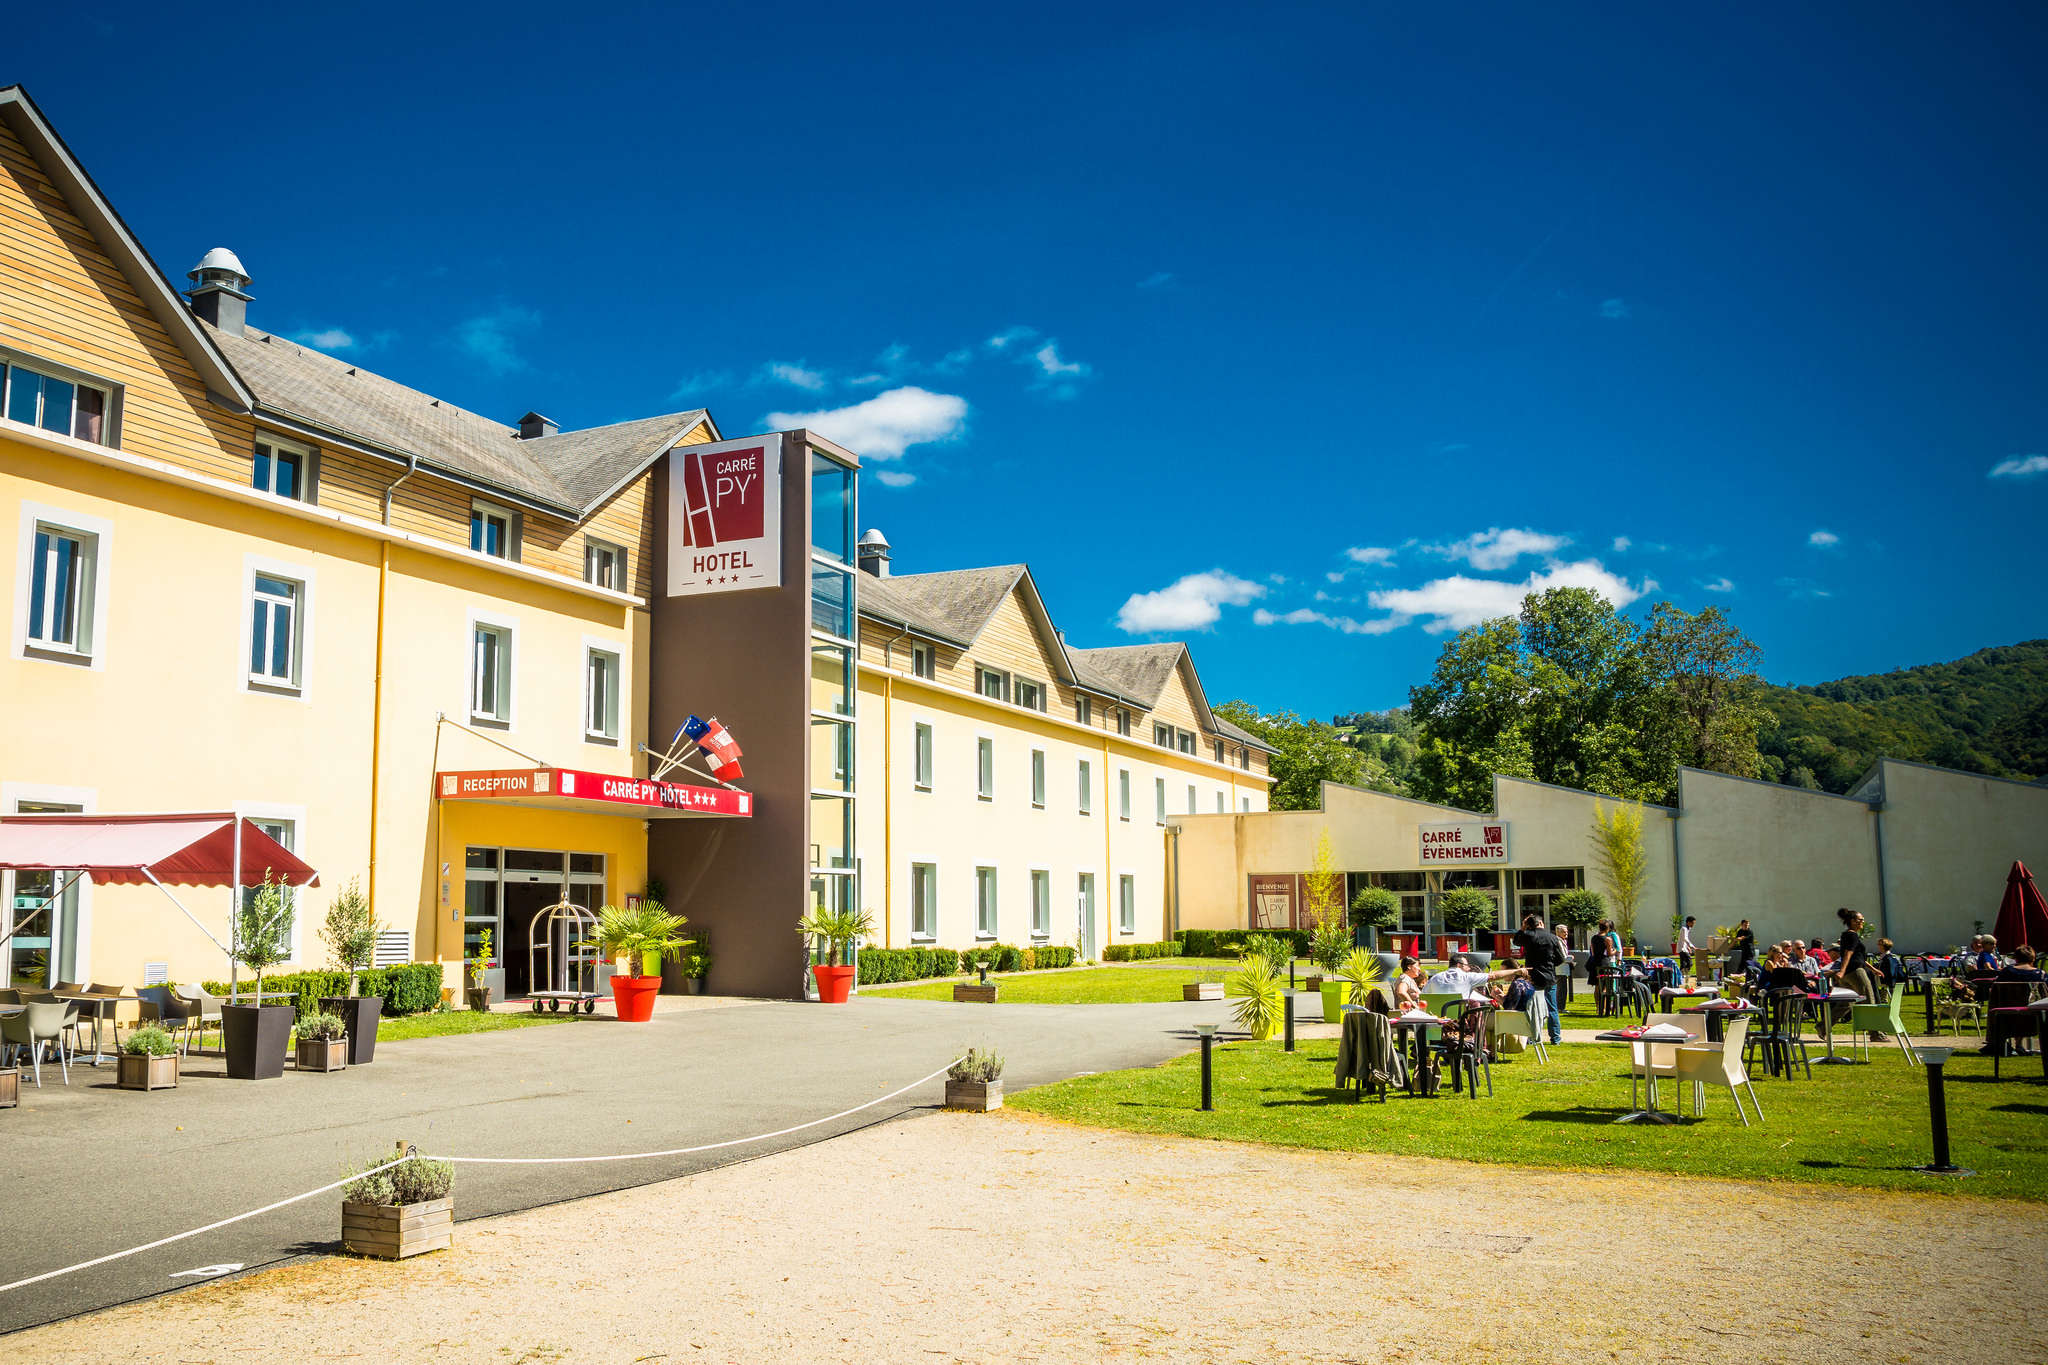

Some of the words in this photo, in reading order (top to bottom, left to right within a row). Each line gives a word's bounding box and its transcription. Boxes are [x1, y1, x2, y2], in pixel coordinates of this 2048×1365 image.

[716, 454, 756, 474] CARRÉ
[693, 551, 753, 573] HOTEL
[463, 777, 527, 791] RECEPTION
[603, 780, 639, 799] CARRÉ
[659, 784, 691, 805] HÔTEL
[1422, 828, 1462, 843] CARRÉ
[1423, 845, 1504, 859] ÉVÈNEMENTS
